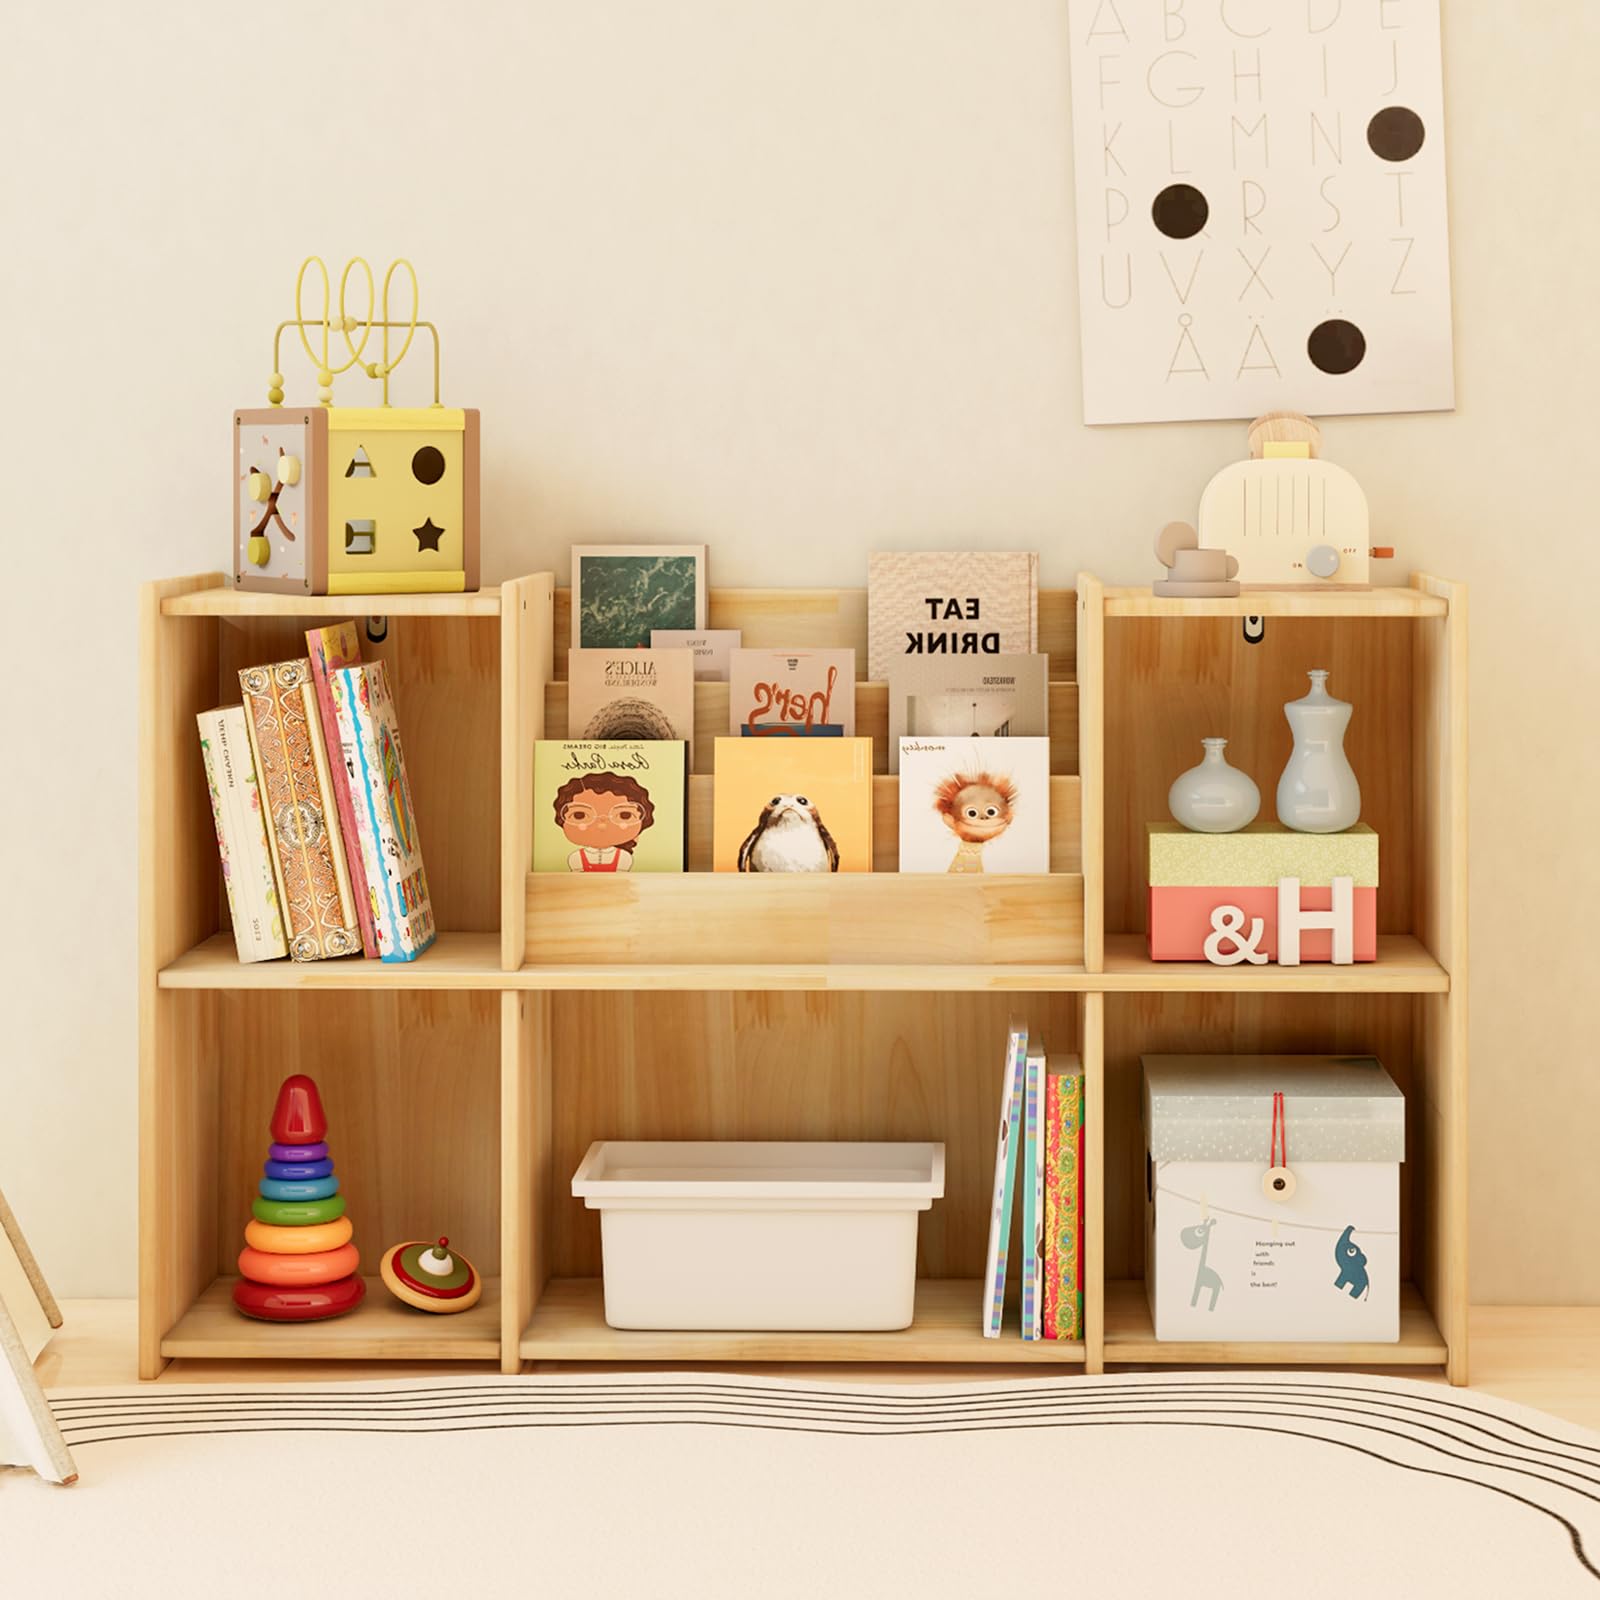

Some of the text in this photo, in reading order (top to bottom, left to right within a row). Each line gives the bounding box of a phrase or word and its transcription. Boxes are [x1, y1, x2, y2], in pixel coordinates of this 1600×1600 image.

[1086, 0, 1130, 46] A
[1163, 0, 1186, 43] B
[1220, 0, 1272, 38] C
[1099, 55, 1121, 110] F
[1146, 50, 1205, 108] G
[1233, 48, 1262, 104] H
[1382, 40, 1398, 96] J
[1104, 111, 1343, 177] K L M N
[1105, 171, 1414, 243] P R S T
[1101, 237, 1417, 309] U V X Y Z
[1166, 313, 1282, 383] Å Ä
